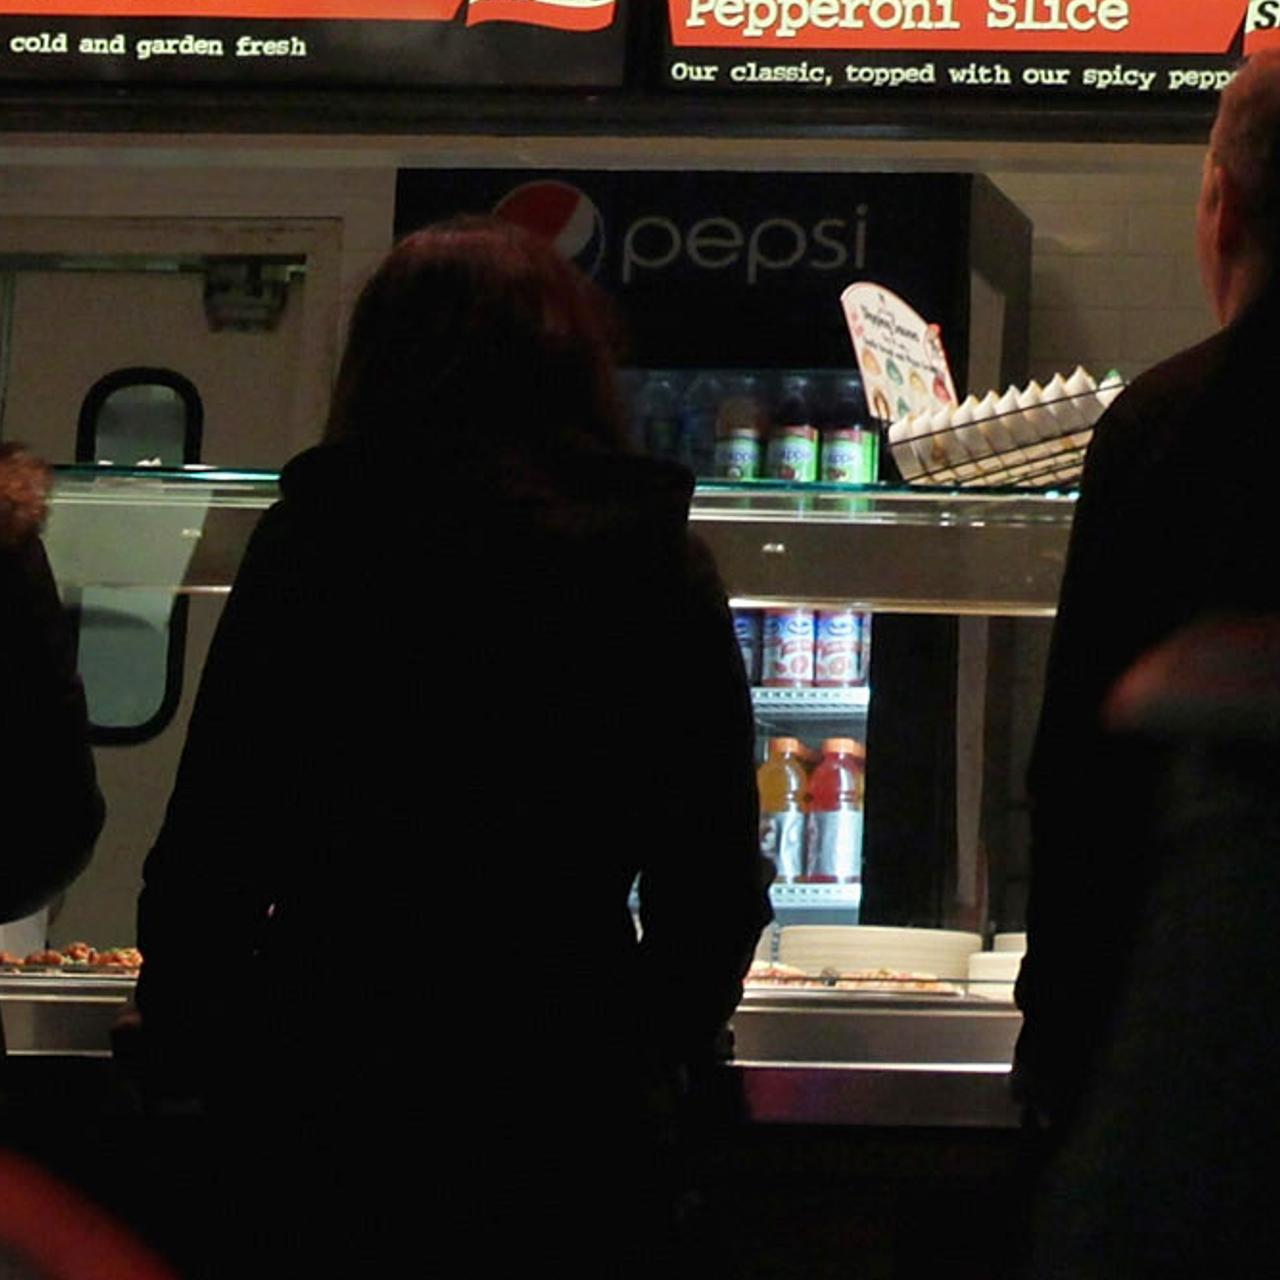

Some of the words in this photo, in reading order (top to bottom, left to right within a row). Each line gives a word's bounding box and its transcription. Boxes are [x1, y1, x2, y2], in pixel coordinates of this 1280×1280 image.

[10, 32, 68, 53] cold
[78, 34, 126, 55] and
[136, 34, 224, 60] garden
[235, 36, 307, 57] fresh
[671, 62, 718, 82] Our
[730, 61, 832, 86] classic,
[845, 62, 936, 87] topped
[949, 61, 1011, 85] with
[1023, 68, 1070, 85] our
[1082, 64, 1157, 91] spicy
[1168, 69, 1240, 91] pepp
[621, 204, 869, 285] pepsi
